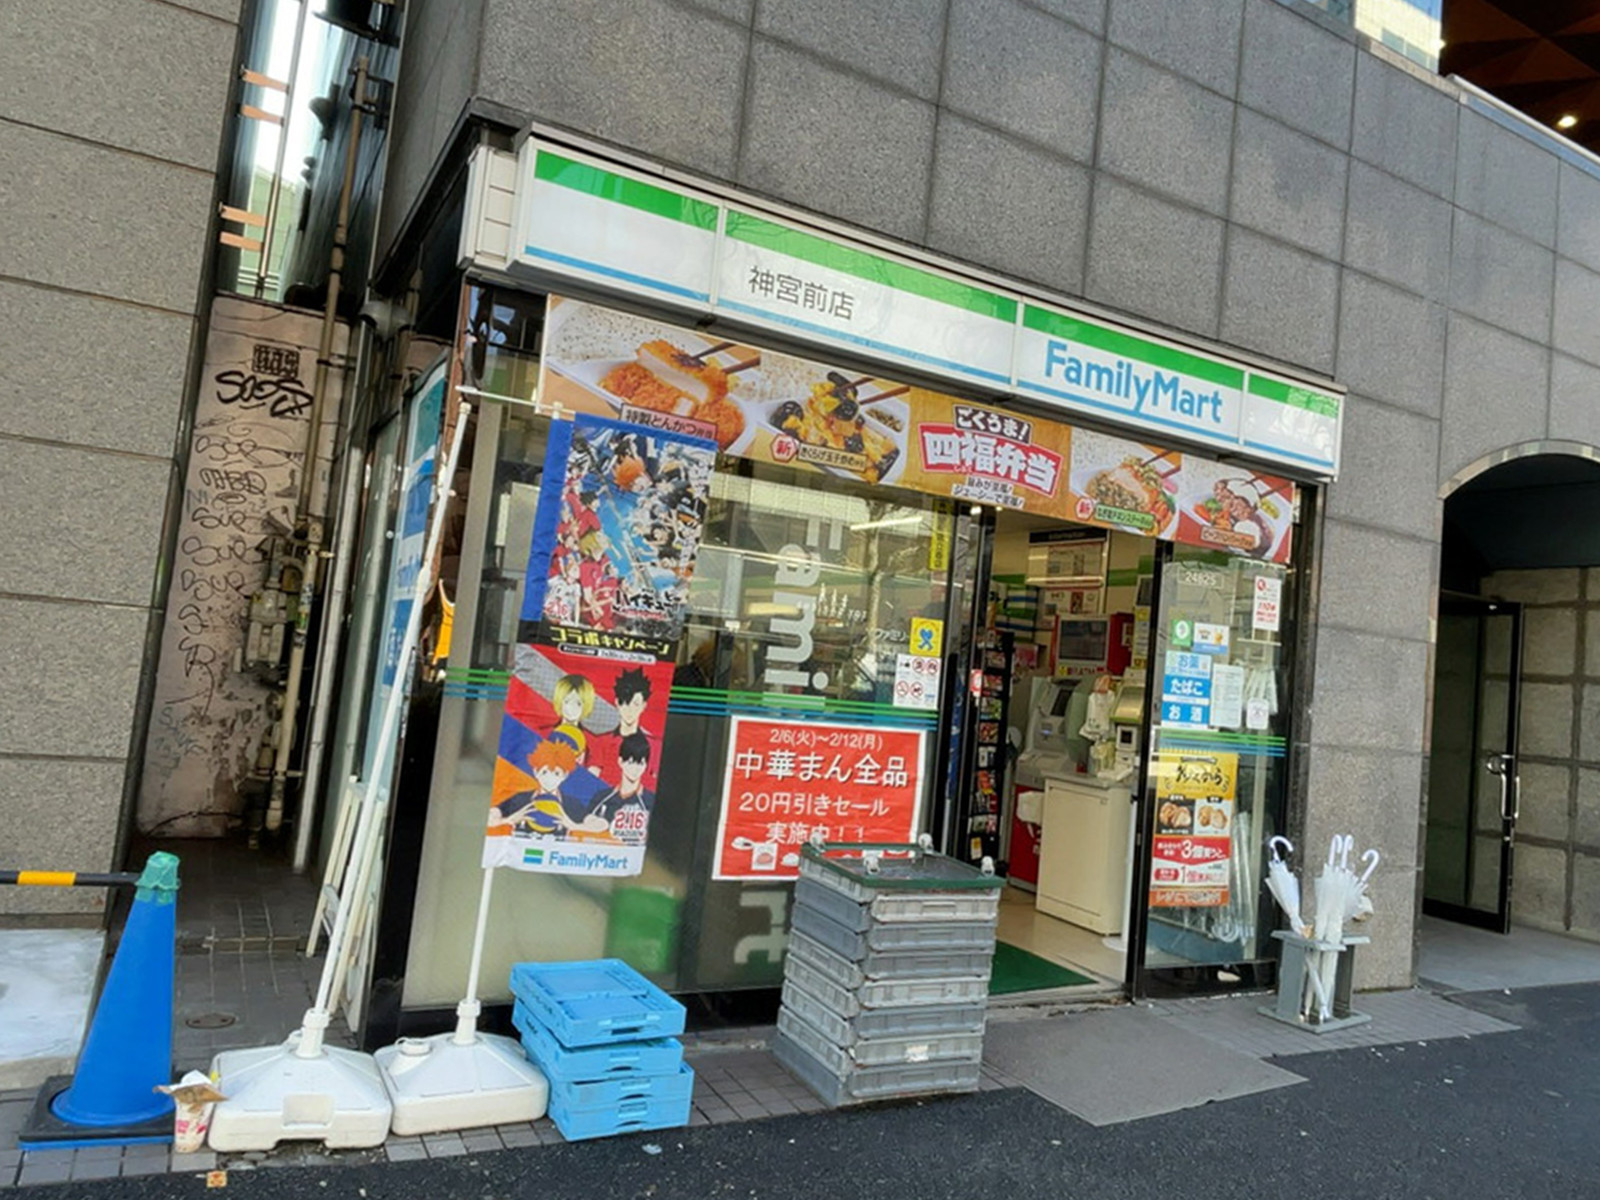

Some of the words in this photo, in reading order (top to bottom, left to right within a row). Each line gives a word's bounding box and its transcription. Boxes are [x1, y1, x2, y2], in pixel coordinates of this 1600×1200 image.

[748, 264, 856, 321] 神宮前店
[1045, 339, 1223, 423] FamilyMart
[923, 431, 1056, 493] 四福弁当
[549, 626, 670, 656] コラボキャンペーン
[1170, 678, 1204, 696] たばこ
[734, 747, 909, 788] 中華まん全品
[739, 790, 890, 818] 20円引きセール
[548, 851, 628, 870] FamilyMart
